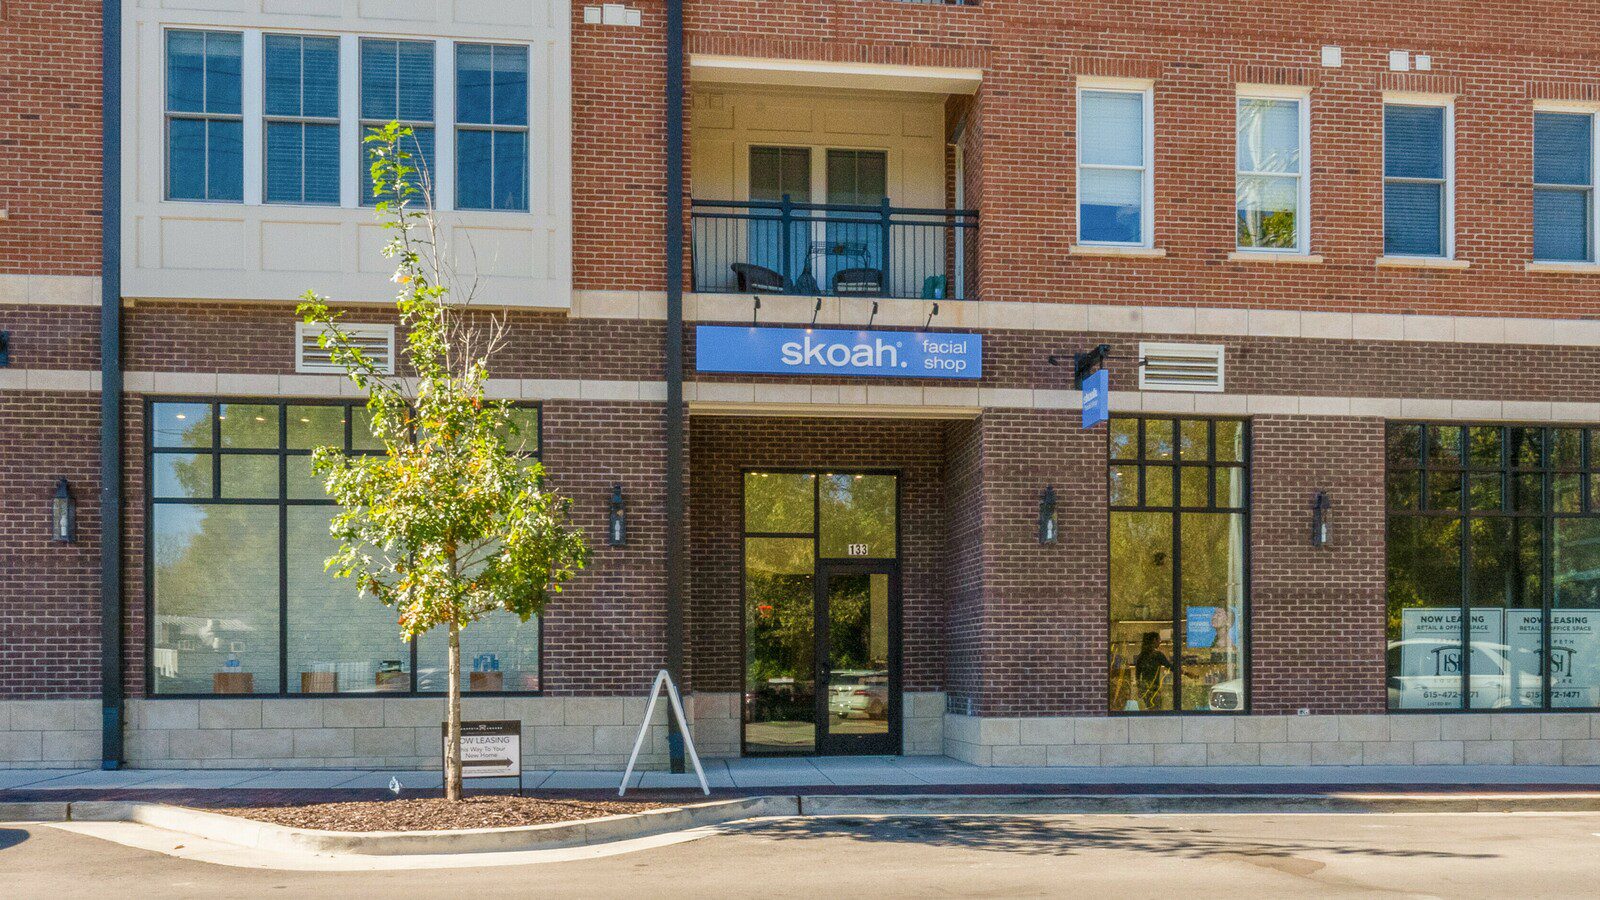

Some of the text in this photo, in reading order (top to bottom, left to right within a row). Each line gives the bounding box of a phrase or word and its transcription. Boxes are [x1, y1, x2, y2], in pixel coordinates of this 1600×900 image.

[922, 339, 967, 355] facial
[924, 356, 967, 373] shop
[850, 544, 867, 555] 133
[1420, 615, 1485, 623] NOW LEANG
[475, 736, 510, 744] LEASING
